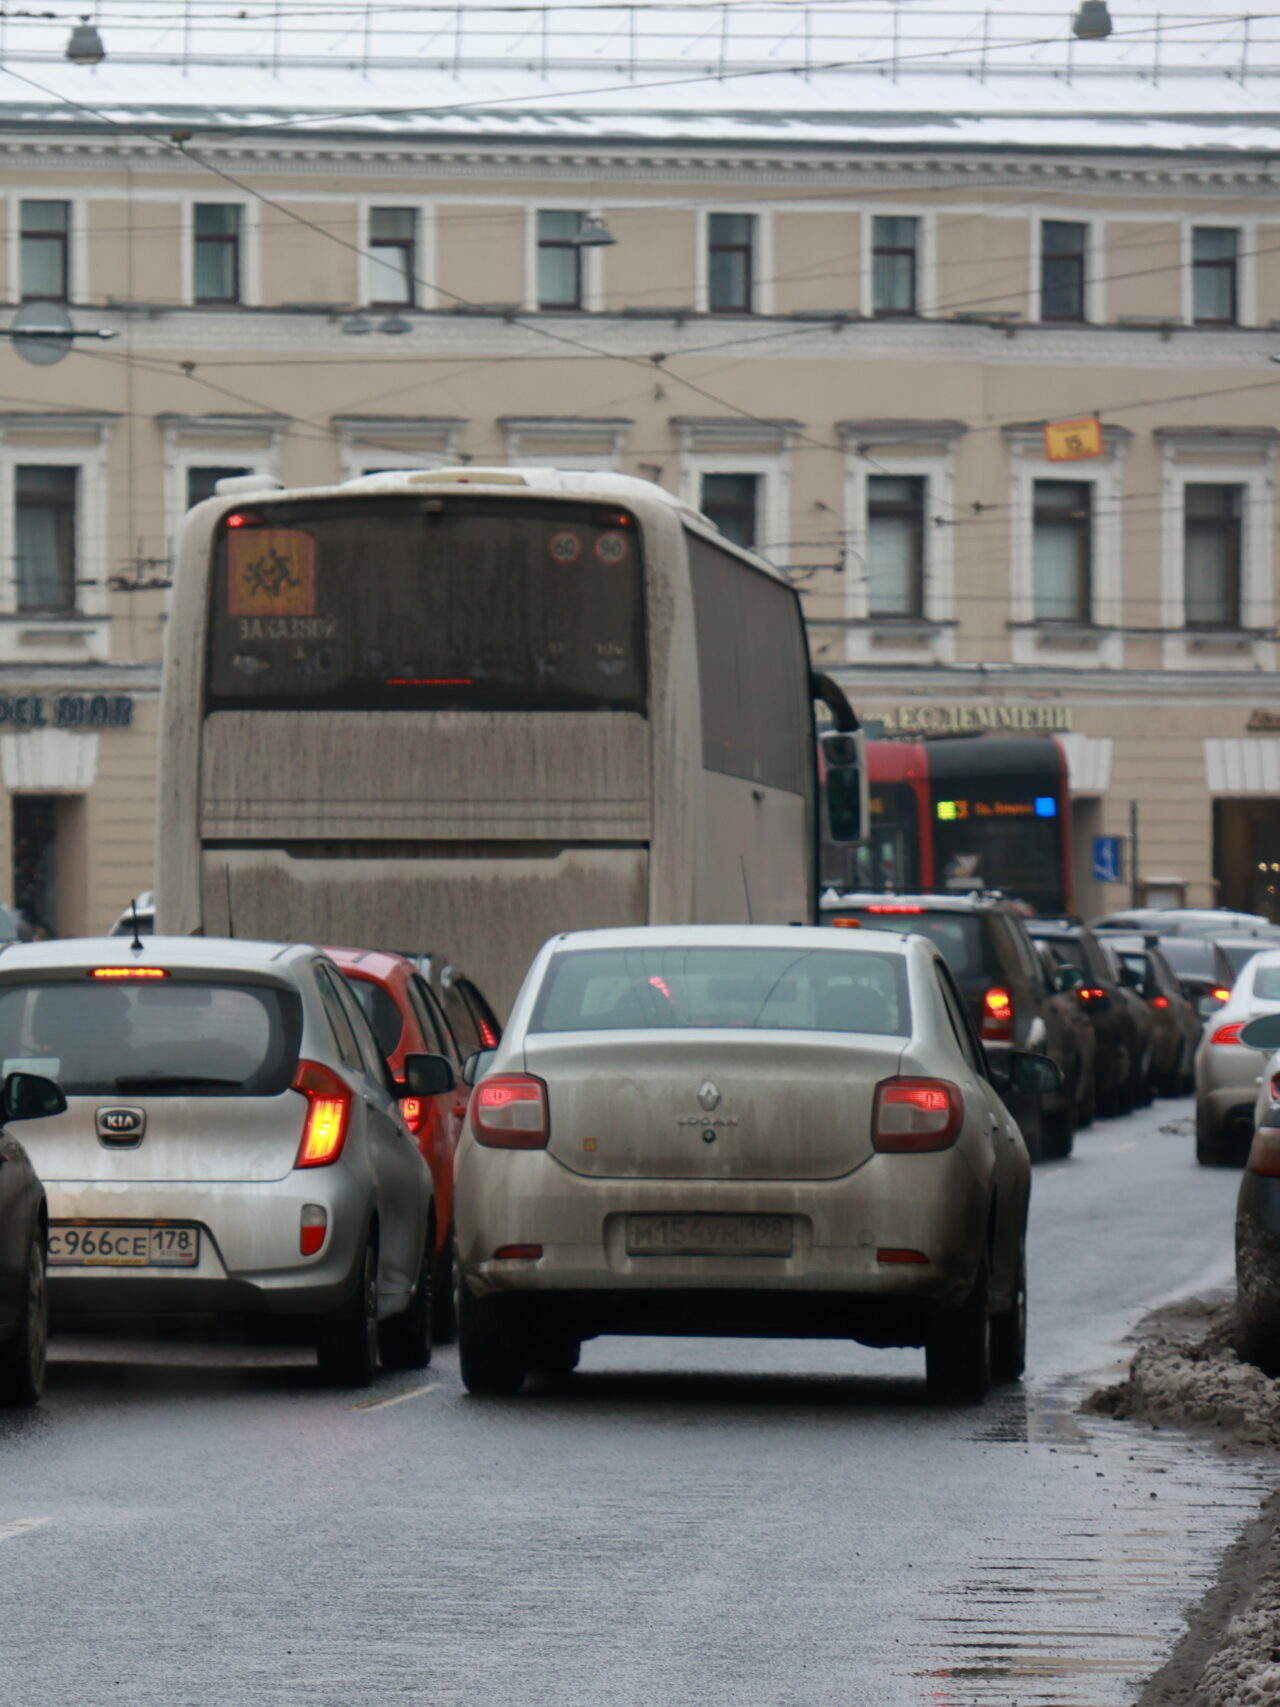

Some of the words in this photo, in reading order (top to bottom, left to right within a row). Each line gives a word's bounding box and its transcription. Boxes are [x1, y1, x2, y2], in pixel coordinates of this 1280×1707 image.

[554, 539, 575, 557] 60
[601, 538, 622, 557] 90
[240, 615, 336, 639] ЗАКАЗНОЙ
[56, 695, 134, 728] MAR
[107, 1114, 135, 1128] KIA
[676, 1117, 739, 1127] LOGAN
[152, 1231, 189, 1250] 178
